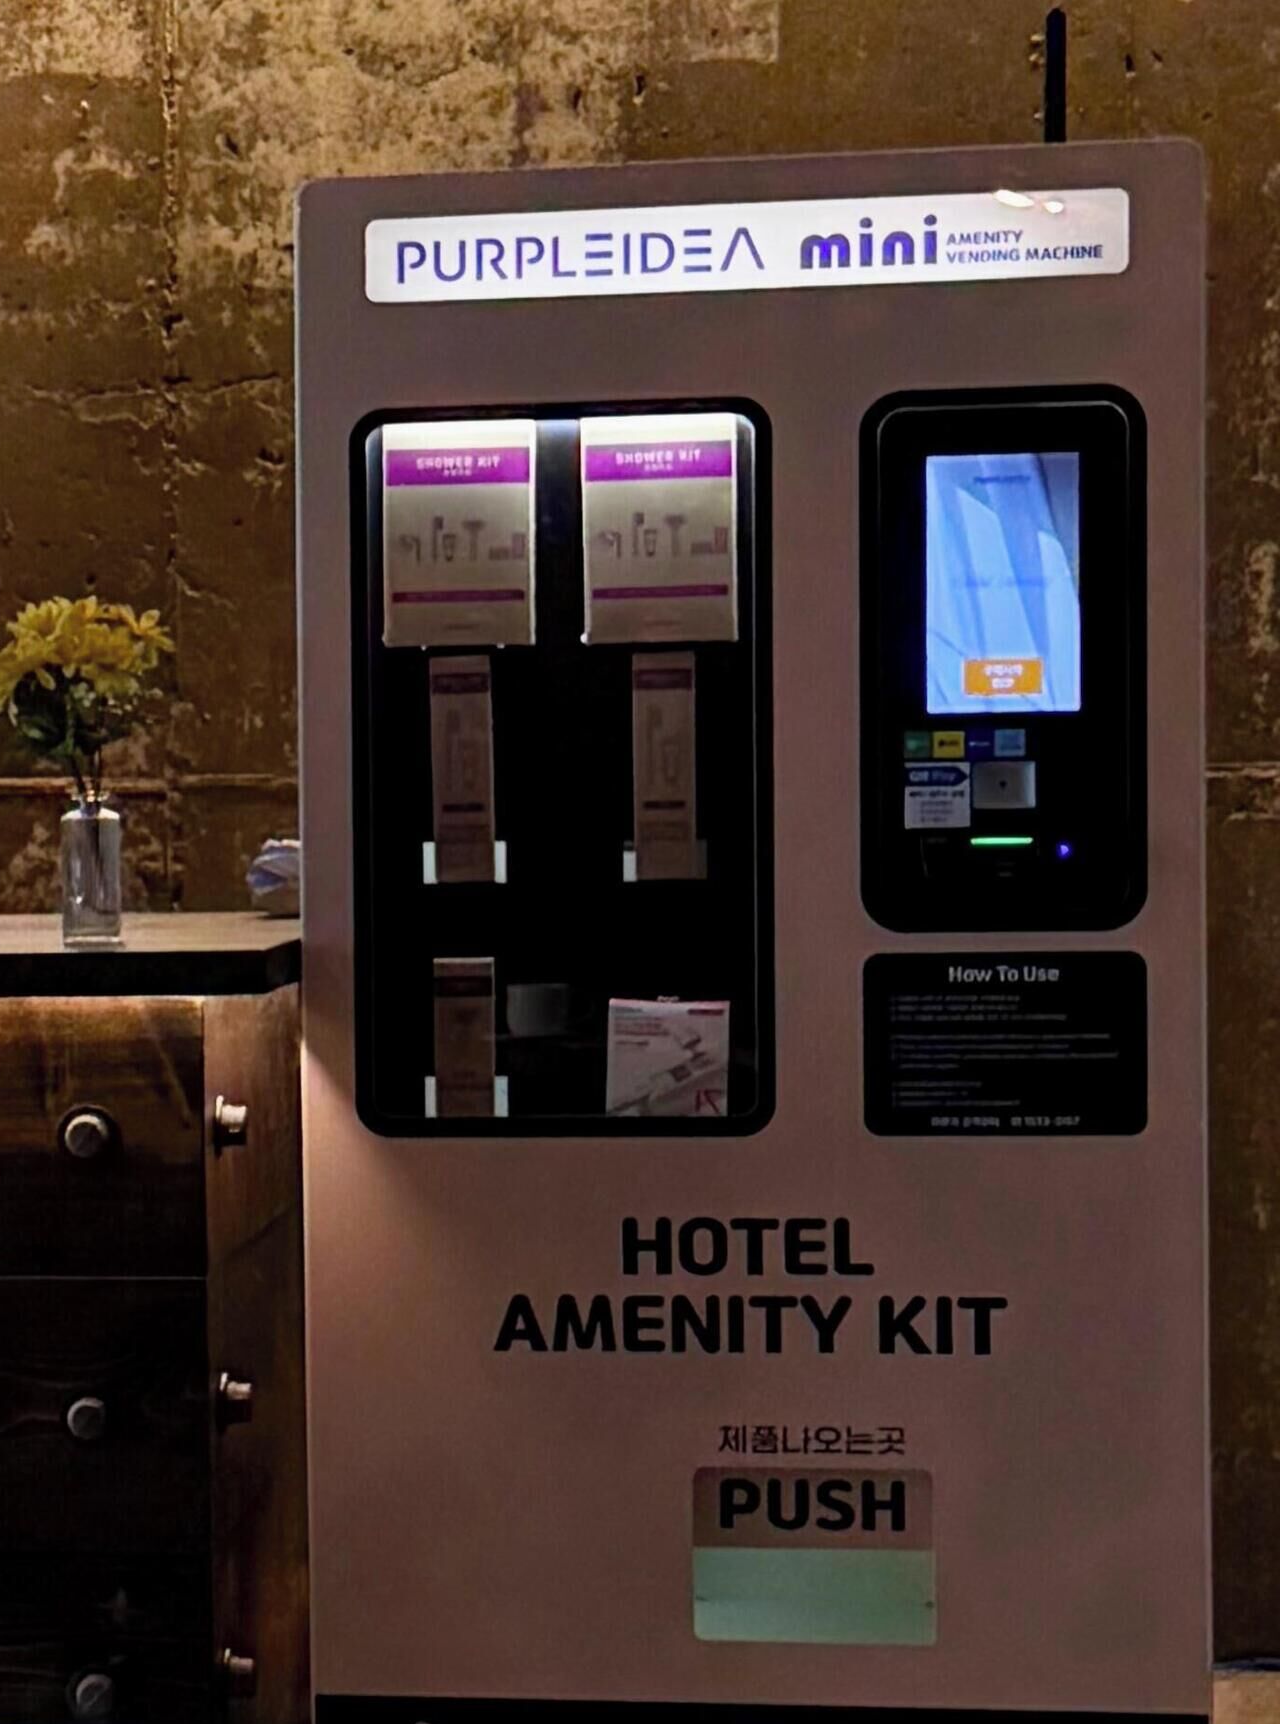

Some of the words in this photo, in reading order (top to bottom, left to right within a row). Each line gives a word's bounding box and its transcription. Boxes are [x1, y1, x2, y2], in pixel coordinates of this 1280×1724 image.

[396, 227, 765, 284] PURPLEIDEA
[799, 214, 938, 269] mini
[946, 229, 1023, 245] AMENITY
[946, 248, 1021, 264] VENDING
[1025, 244, 1103, 261] MACHINE
[415, 456, 473, 470] SHOWER
[477, 455, 502, 468] KIT
[615, 450, 673, 464] SHOWER
[678, 448, 702, 462] KIT
[948, 966, 992, 982] How
[996, 965, 1019, 982] To
[1023, 966, 1060, 982] Use
[621, 1216, 875, 1275] HOTEL
[493, 1294, 853, 1354] AMENITY
[878, 1296, 1008, 1355] KIT
[717, 1424, 906, 1456] 제품나오는곳
[718, 1477, 906, 1532] PUSH
